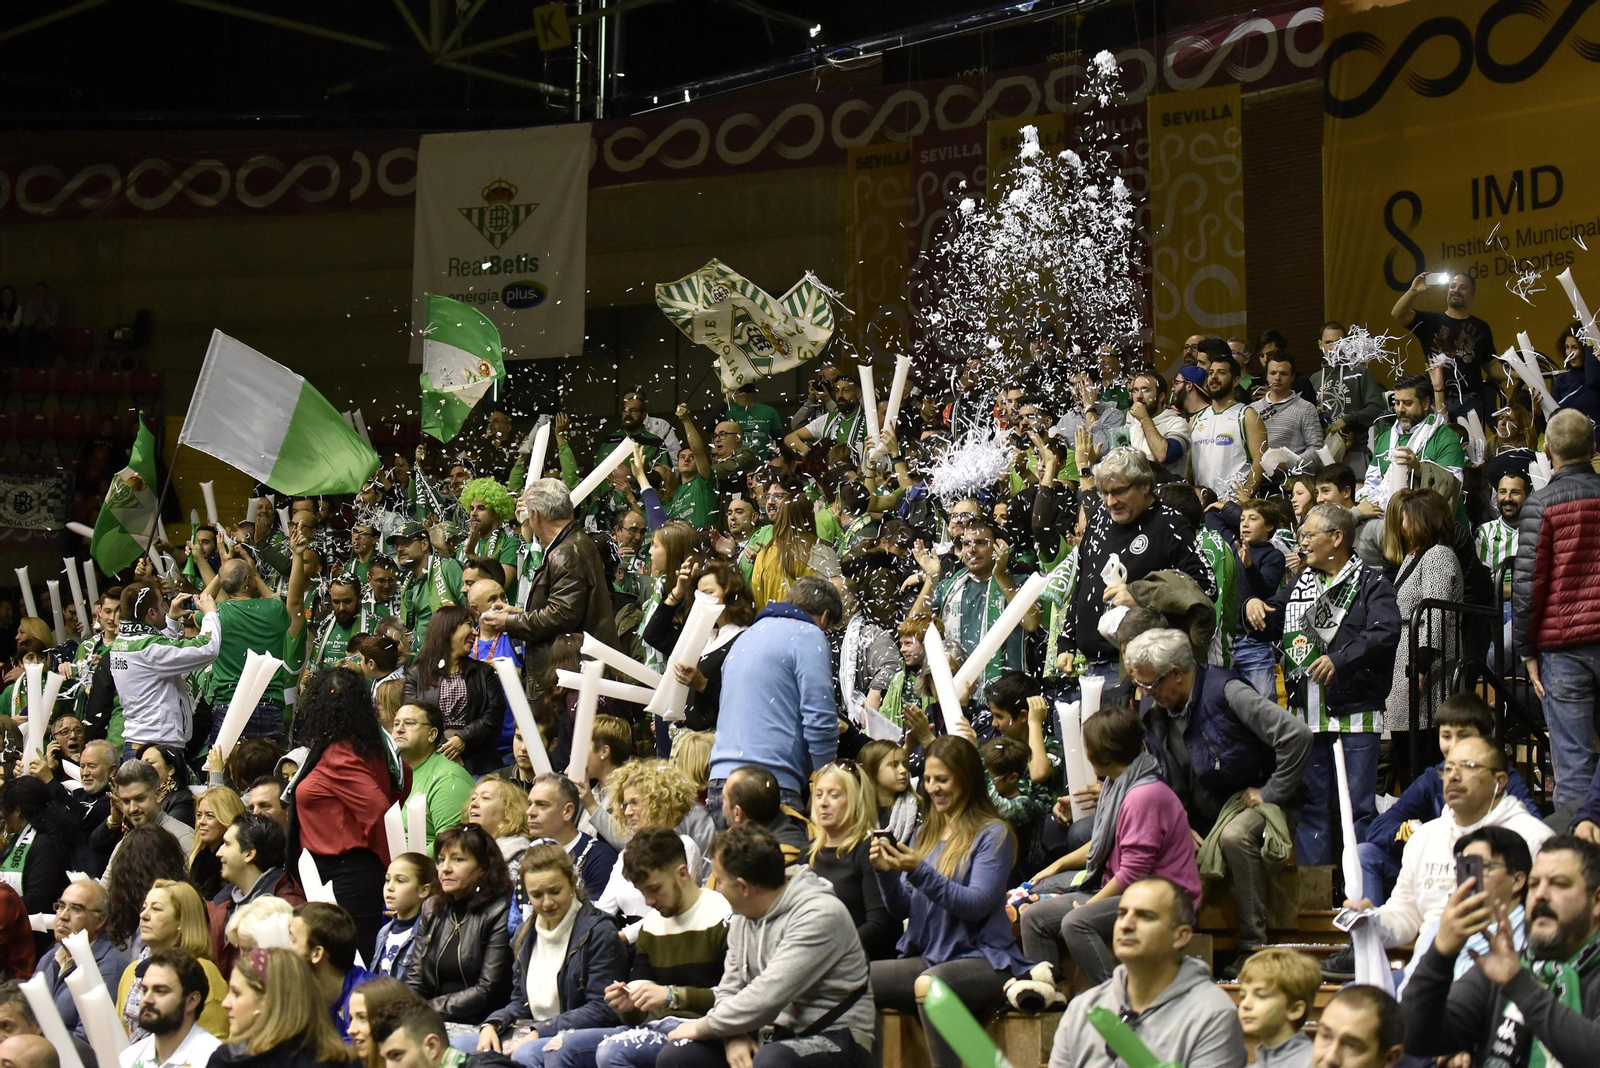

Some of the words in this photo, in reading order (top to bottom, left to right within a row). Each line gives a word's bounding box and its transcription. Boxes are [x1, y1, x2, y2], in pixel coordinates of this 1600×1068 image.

[540, 10, 561, 43] K
[1161, 104, 1233, 127] SEVILLA
[999, 130, 1064, 151] SELLA
[855, 149, 911, 170] SEVILLA
[920, 142, 982, 164] SEVILLA
[1471, 164, 1564, 220] IMD
[1441, 236, 1510, 261] Instituto
[1516, 215, 1600, 247] Municipal
[1468, 260, 1490, 280] de
[1495, 249, 1576, 277] Deportes
[506, 288, 536, 303] plus
[25, 514, 54, 527] LOCAL
[434, 567, 448, 597] REAL
